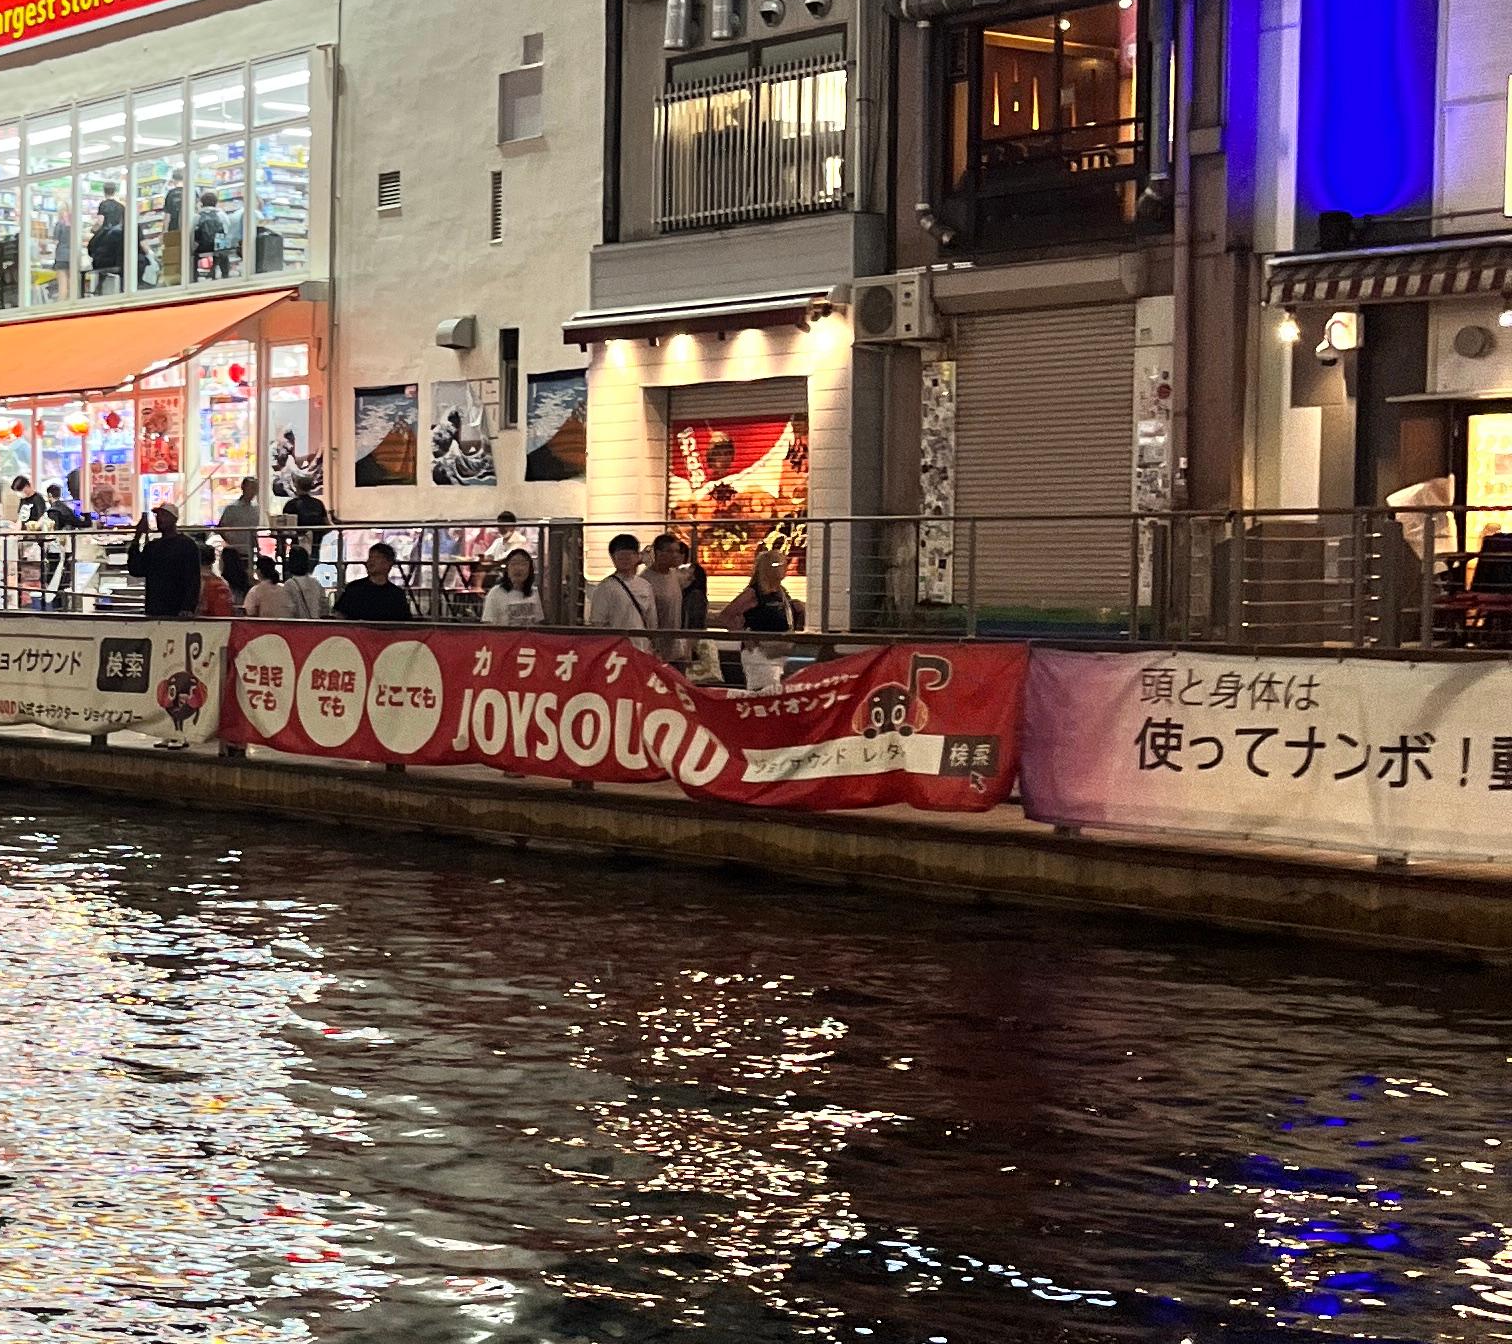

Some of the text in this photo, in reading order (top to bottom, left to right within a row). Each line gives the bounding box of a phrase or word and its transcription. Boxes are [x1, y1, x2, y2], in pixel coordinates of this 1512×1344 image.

[106, 650, 145, 679] 検索
[242, 664, 284, 688] ご自宅
[310, 668, 357, 694] 飲食店
[1139, 667, 1321, 712] 頭と身体は
[246, 689, 277, 712] でも
[317, 695, 346, 718] でも
[375, 684, 437, 709] どこでも
[452, 688, 730, 787] JOYSOUND
